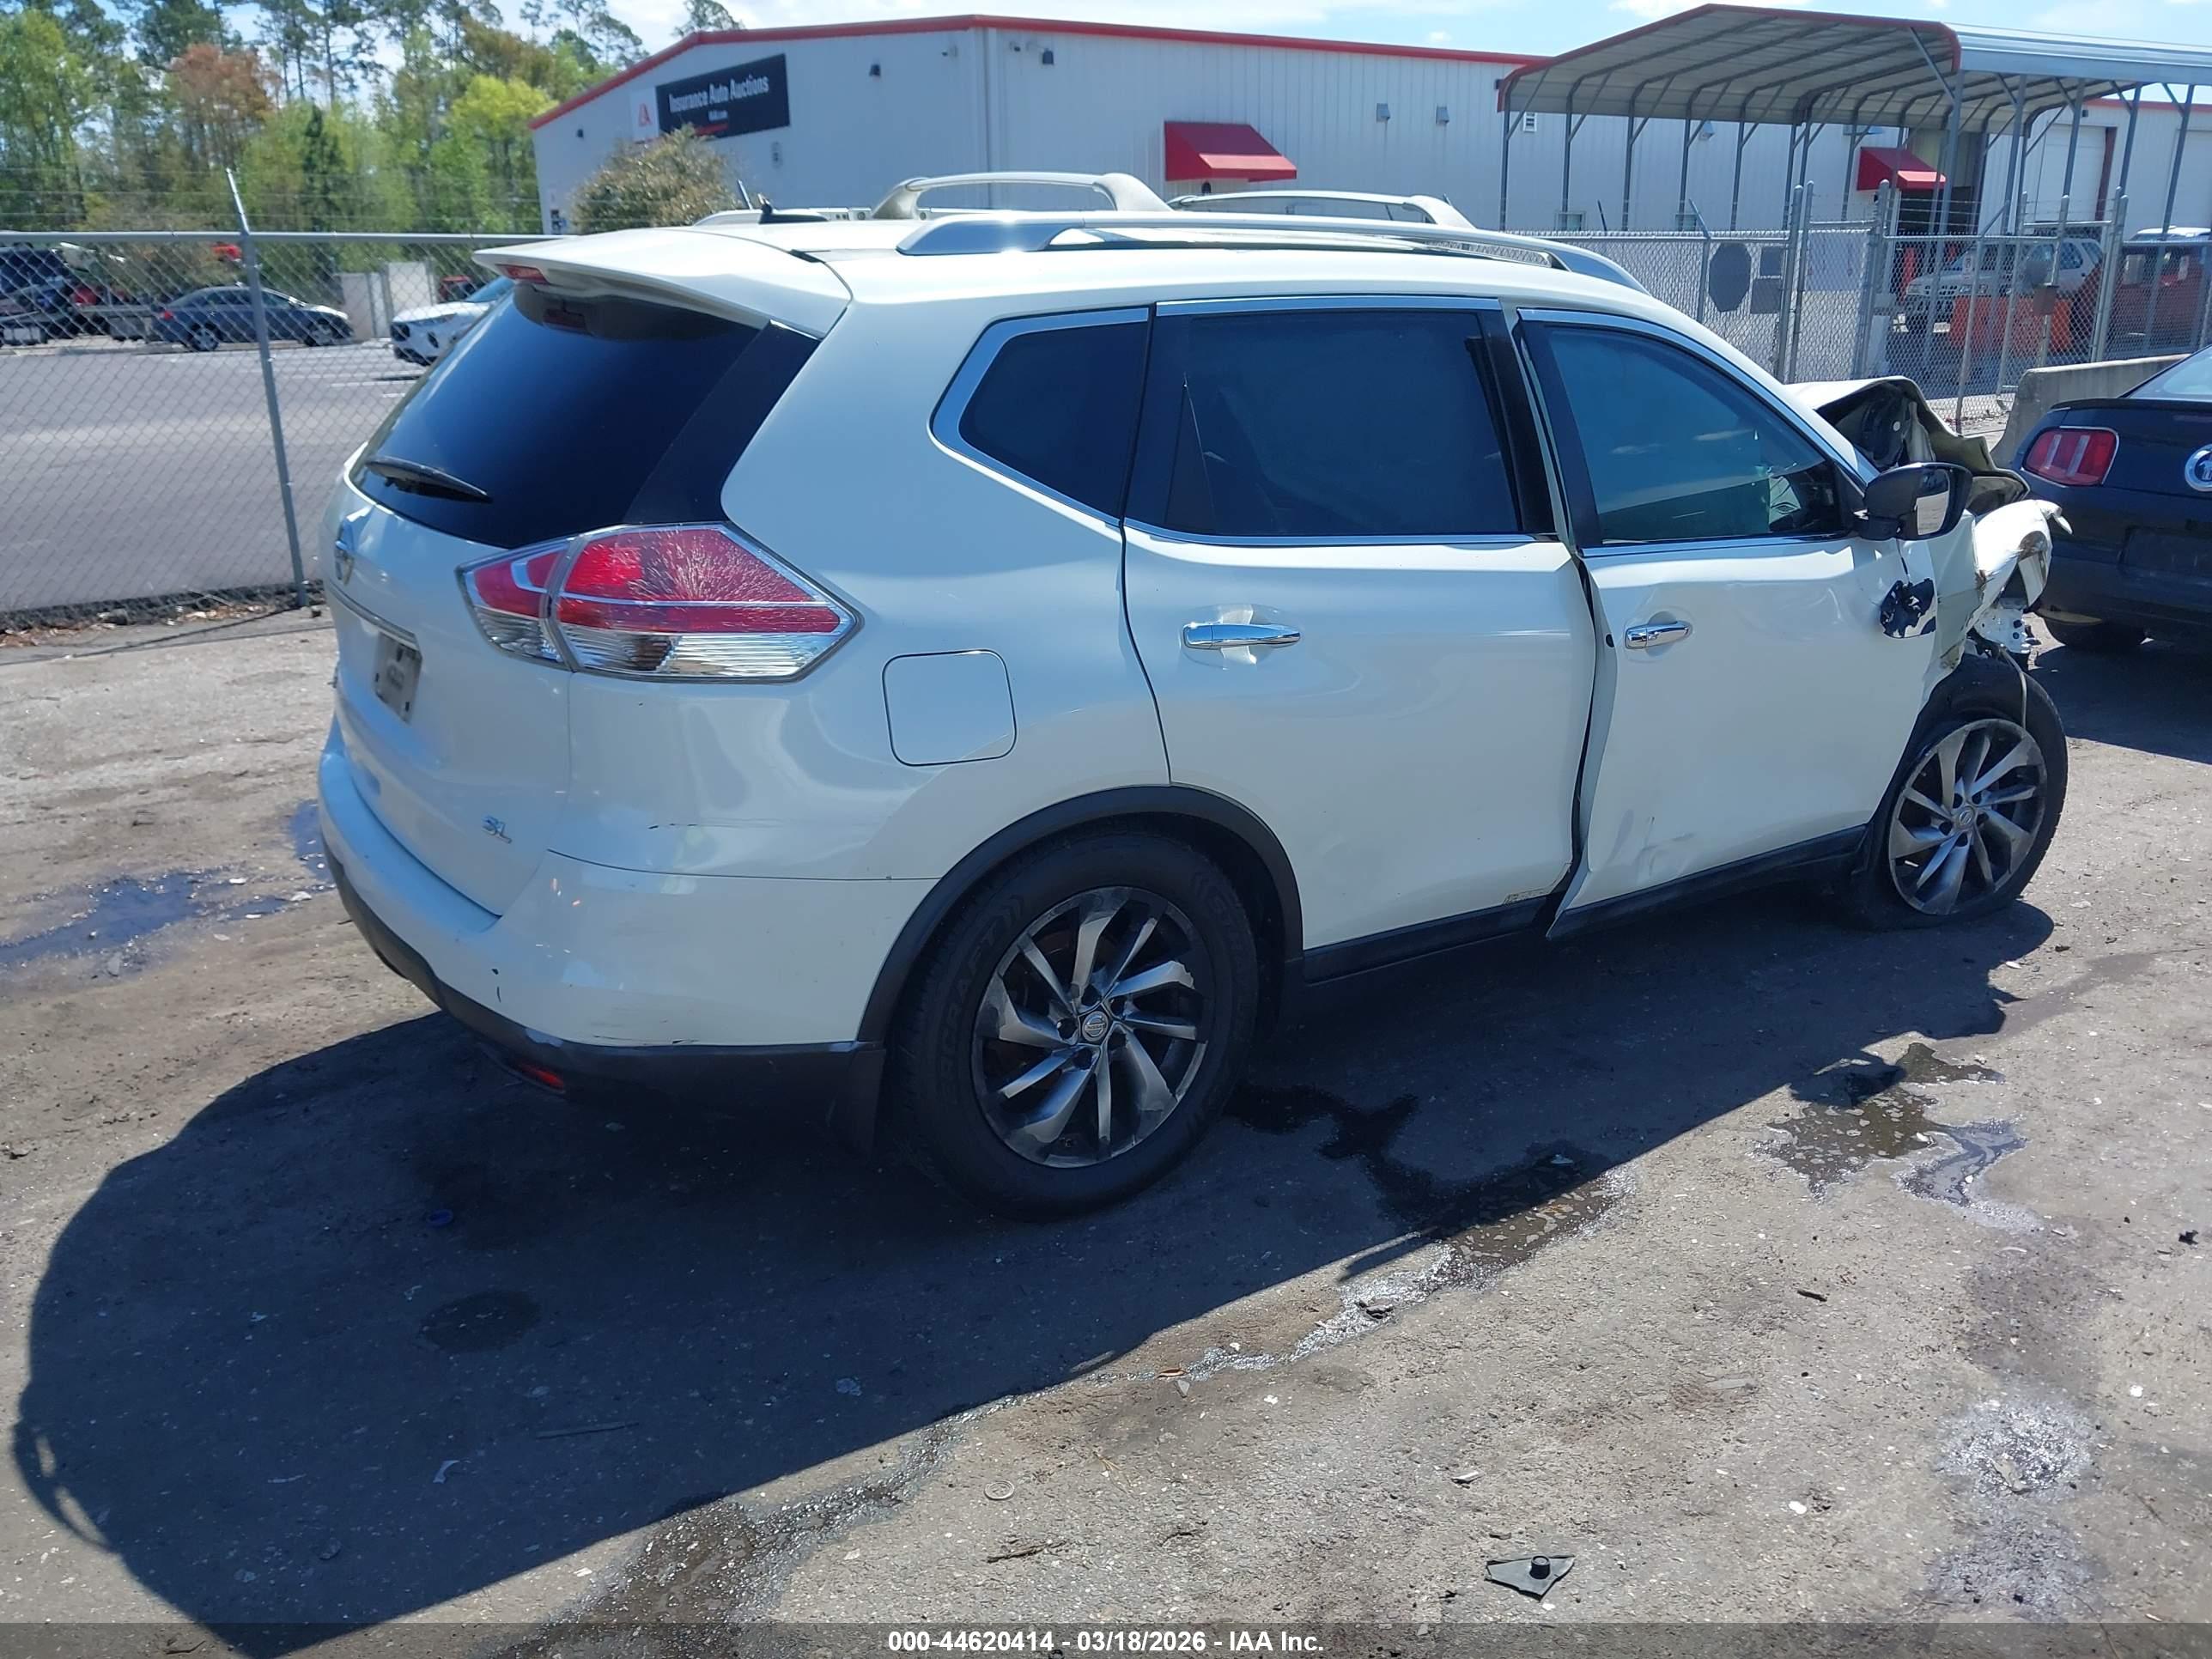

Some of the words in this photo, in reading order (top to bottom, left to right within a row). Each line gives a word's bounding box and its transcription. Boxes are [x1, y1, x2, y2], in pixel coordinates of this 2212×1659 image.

[669, 93, 708, 113] Insurance
[709, 83, 729, 105] Auto
[730, 75, 769, 100] Auctions
[482, 816, 513, 843] SL
